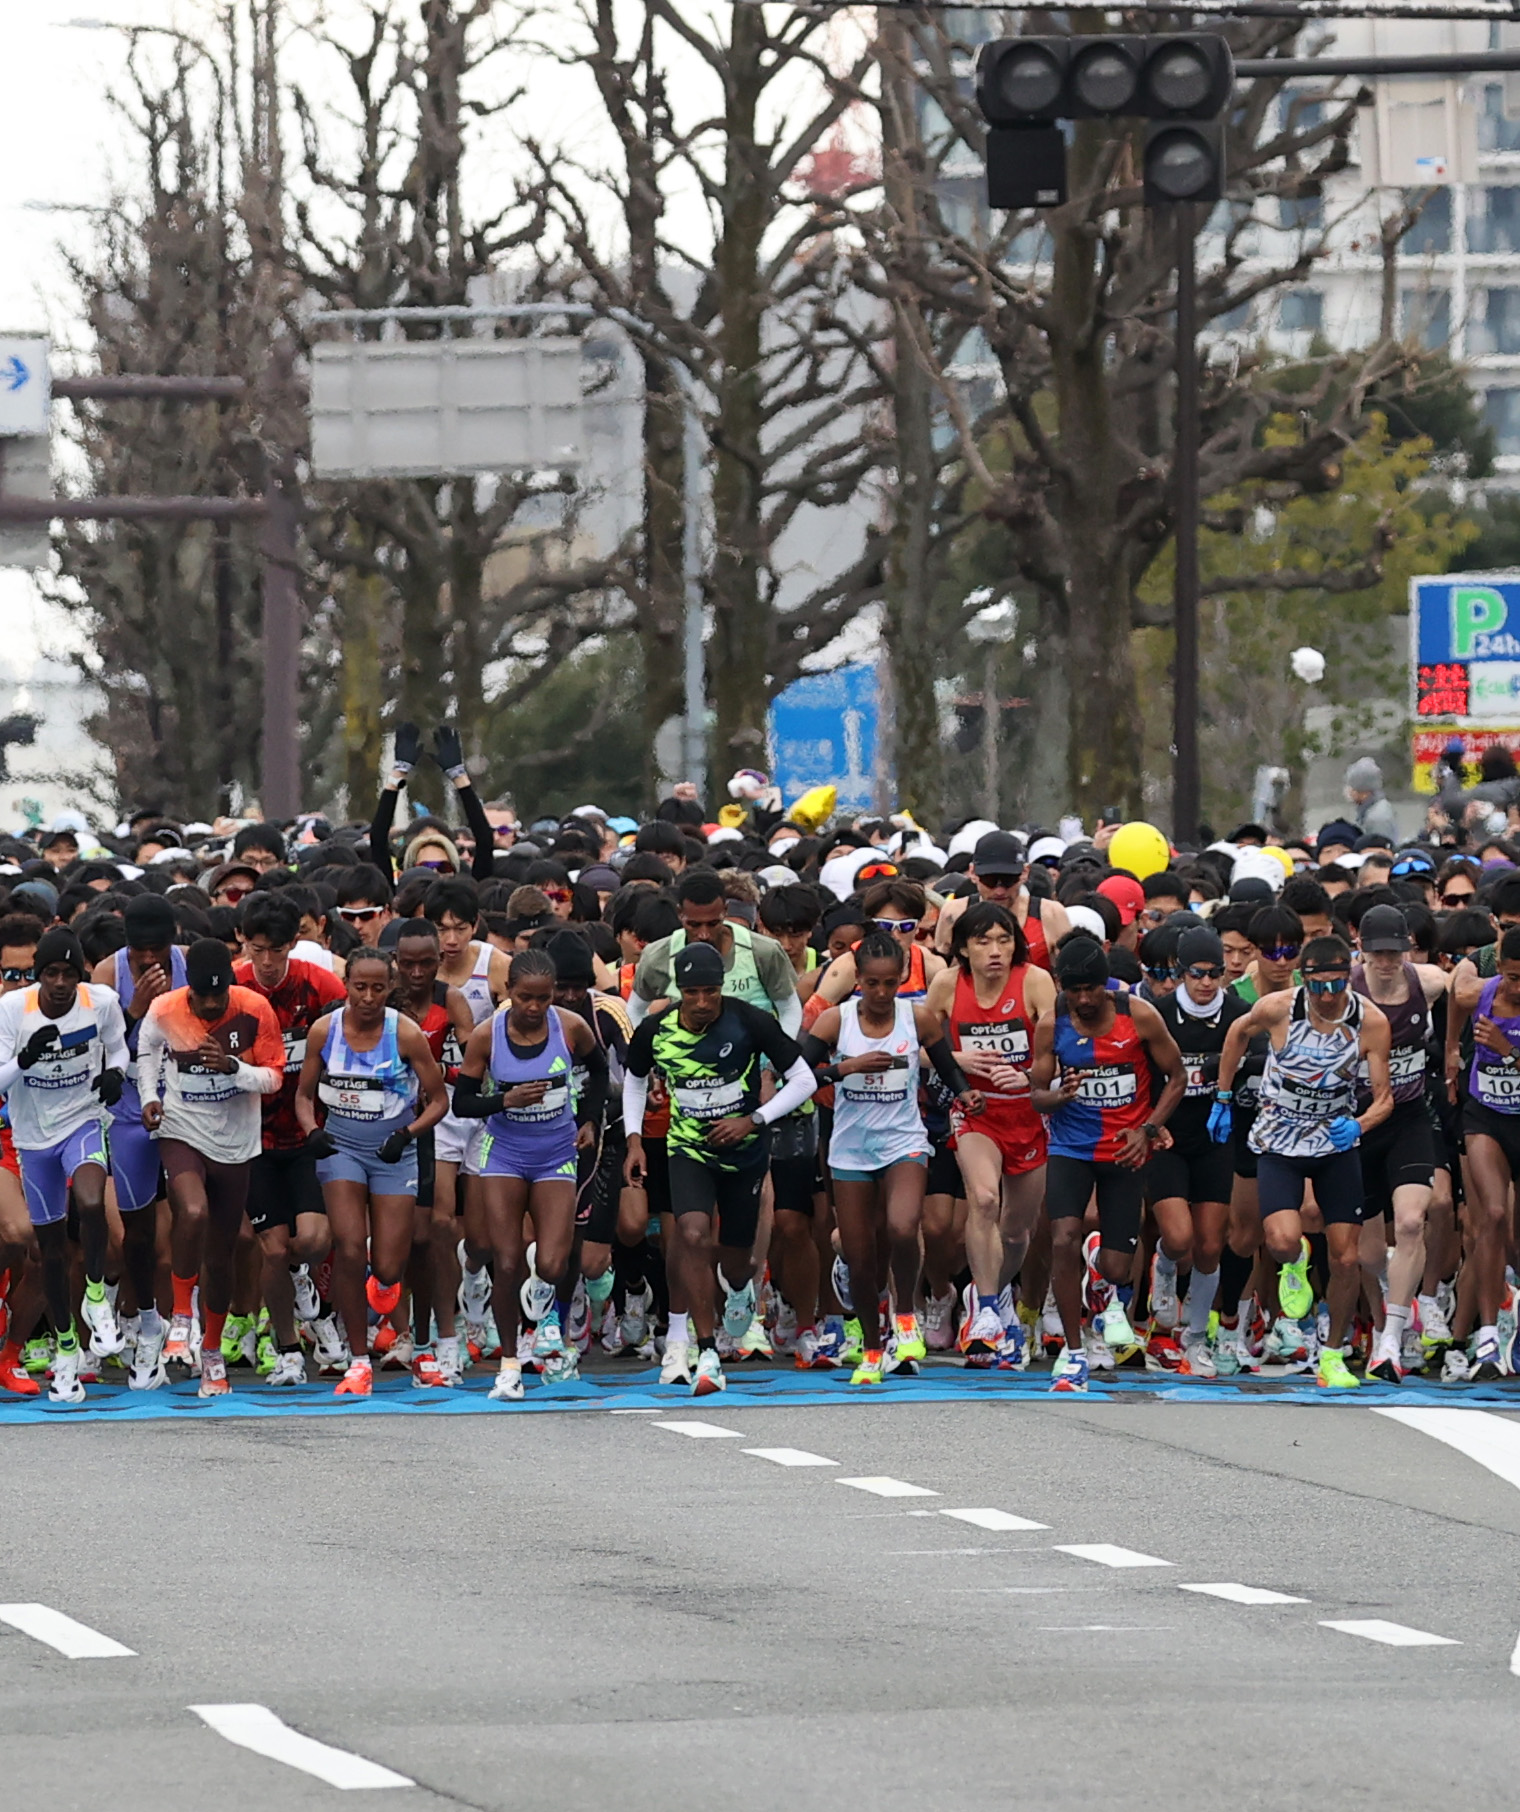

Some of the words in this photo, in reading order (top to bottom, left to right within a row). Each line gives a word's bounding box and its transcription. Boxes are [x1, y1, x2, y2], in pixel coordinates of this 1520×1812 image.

[1451, 587, 1508, 658] P
[970, 1023, 1009, 1036] OPTAGE
[1389, 1046, 1413, 1058] TAGE
[1002, 1053, 1026, 1065] etro
[52, 1064, 62, 1074] 4
[284, 1064, 303, 1073] etro
[1485, 1066, 1520, 1076] OPTAG
[29, 1076, 58, 1088] Osaka
[58, 1073, 88, 1087] Metro
[209, 1077, 216, 1088] 1
[330, 1078, 368, 1090] OPTAGE
[685, 1076, 725, 1088] OPTAGE
[864, 1074, 885, 1085] 51
[1395, 1073, 1421, 1085] Metro
[1081, 1080, 1120, 1097] 101
[1295, 1085, 1336, 1099] OPTAGE
[186, 1093, 215, 1103] Osaka
[339, 1093, 360, 1104] 55
[702, 1091, 713, 1103] 7
[846, 1090, 876, 1101] Osaka
[877, 1089, 905, 1101] Metro
[1108, 1094, 1132, 1106] Metro
[1483, 1093, 1509, 1105] Osaka
[1291, 1097, 1330, 1114] 141
[506, 1110, 535, 1122] Osaka
[537, 1107, 564, 1120] Metro
[682, 1107, 712, 1118] Osaka
